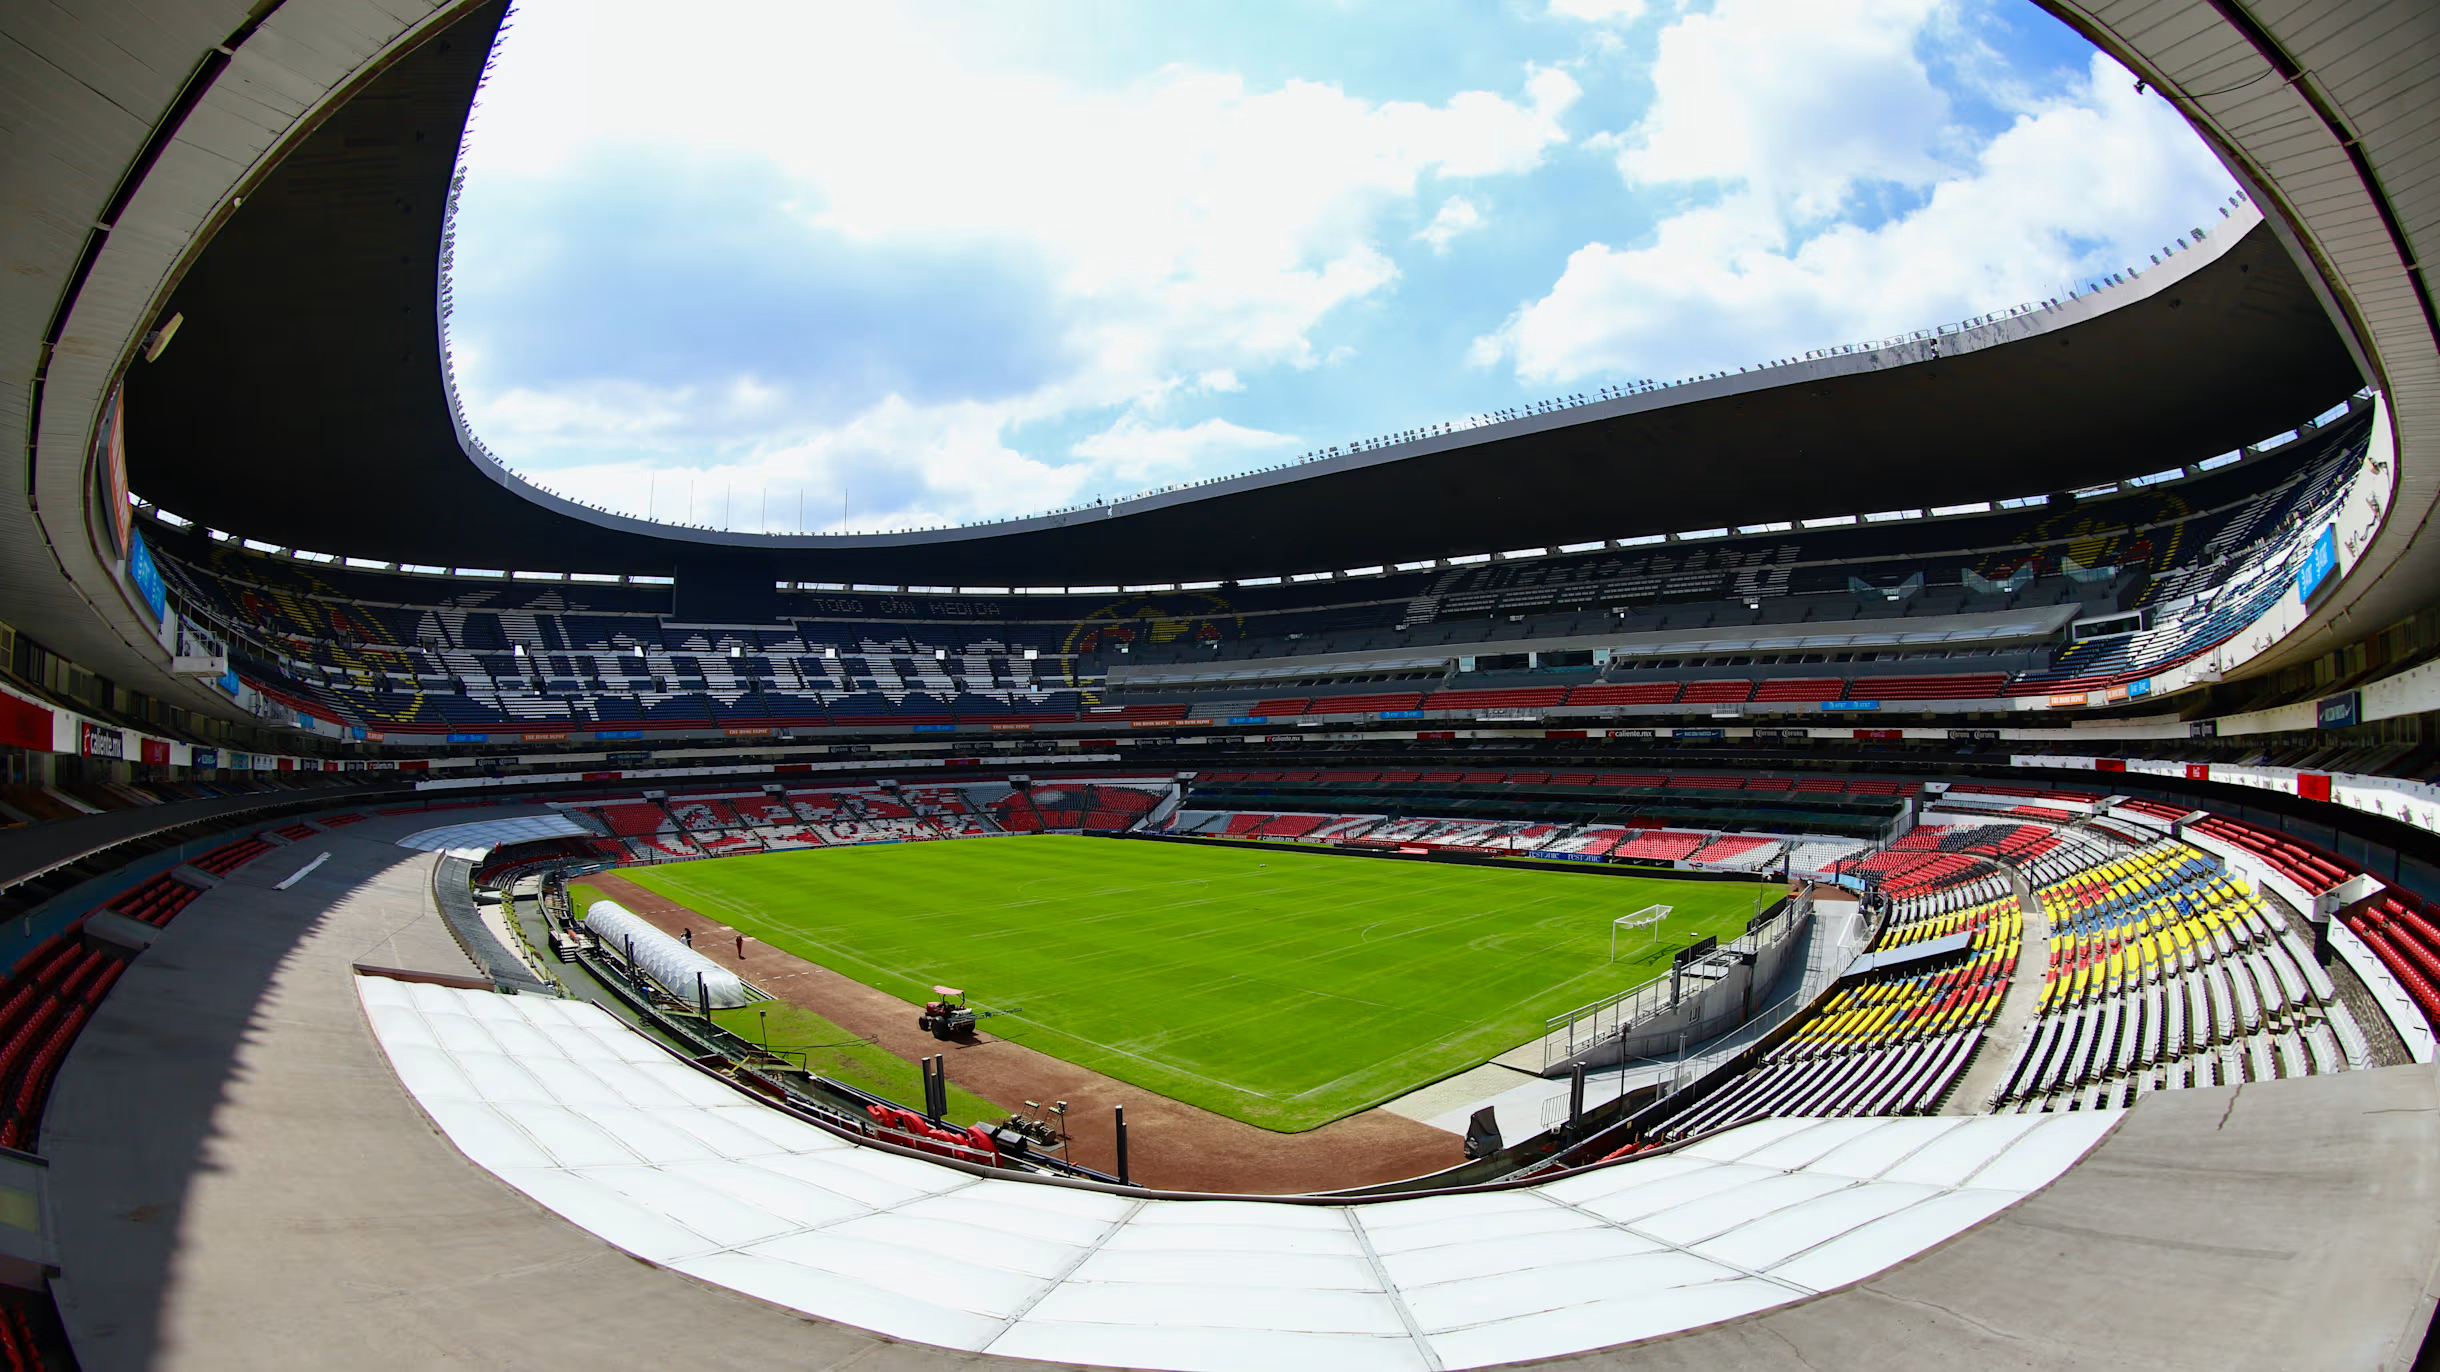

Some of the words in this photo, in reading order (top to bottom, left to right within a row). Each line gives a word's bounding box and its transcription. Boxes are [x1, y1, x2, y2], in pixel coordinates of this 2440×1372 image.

[812, 599, 863, 612] TODO
[928, 602, 1000, 615] MEDIDA
[1950, 730, 1969, 739] Corona
[1974, 730, 1995, 739] Corona
[91, 728, 121, 758] caliente.mx
